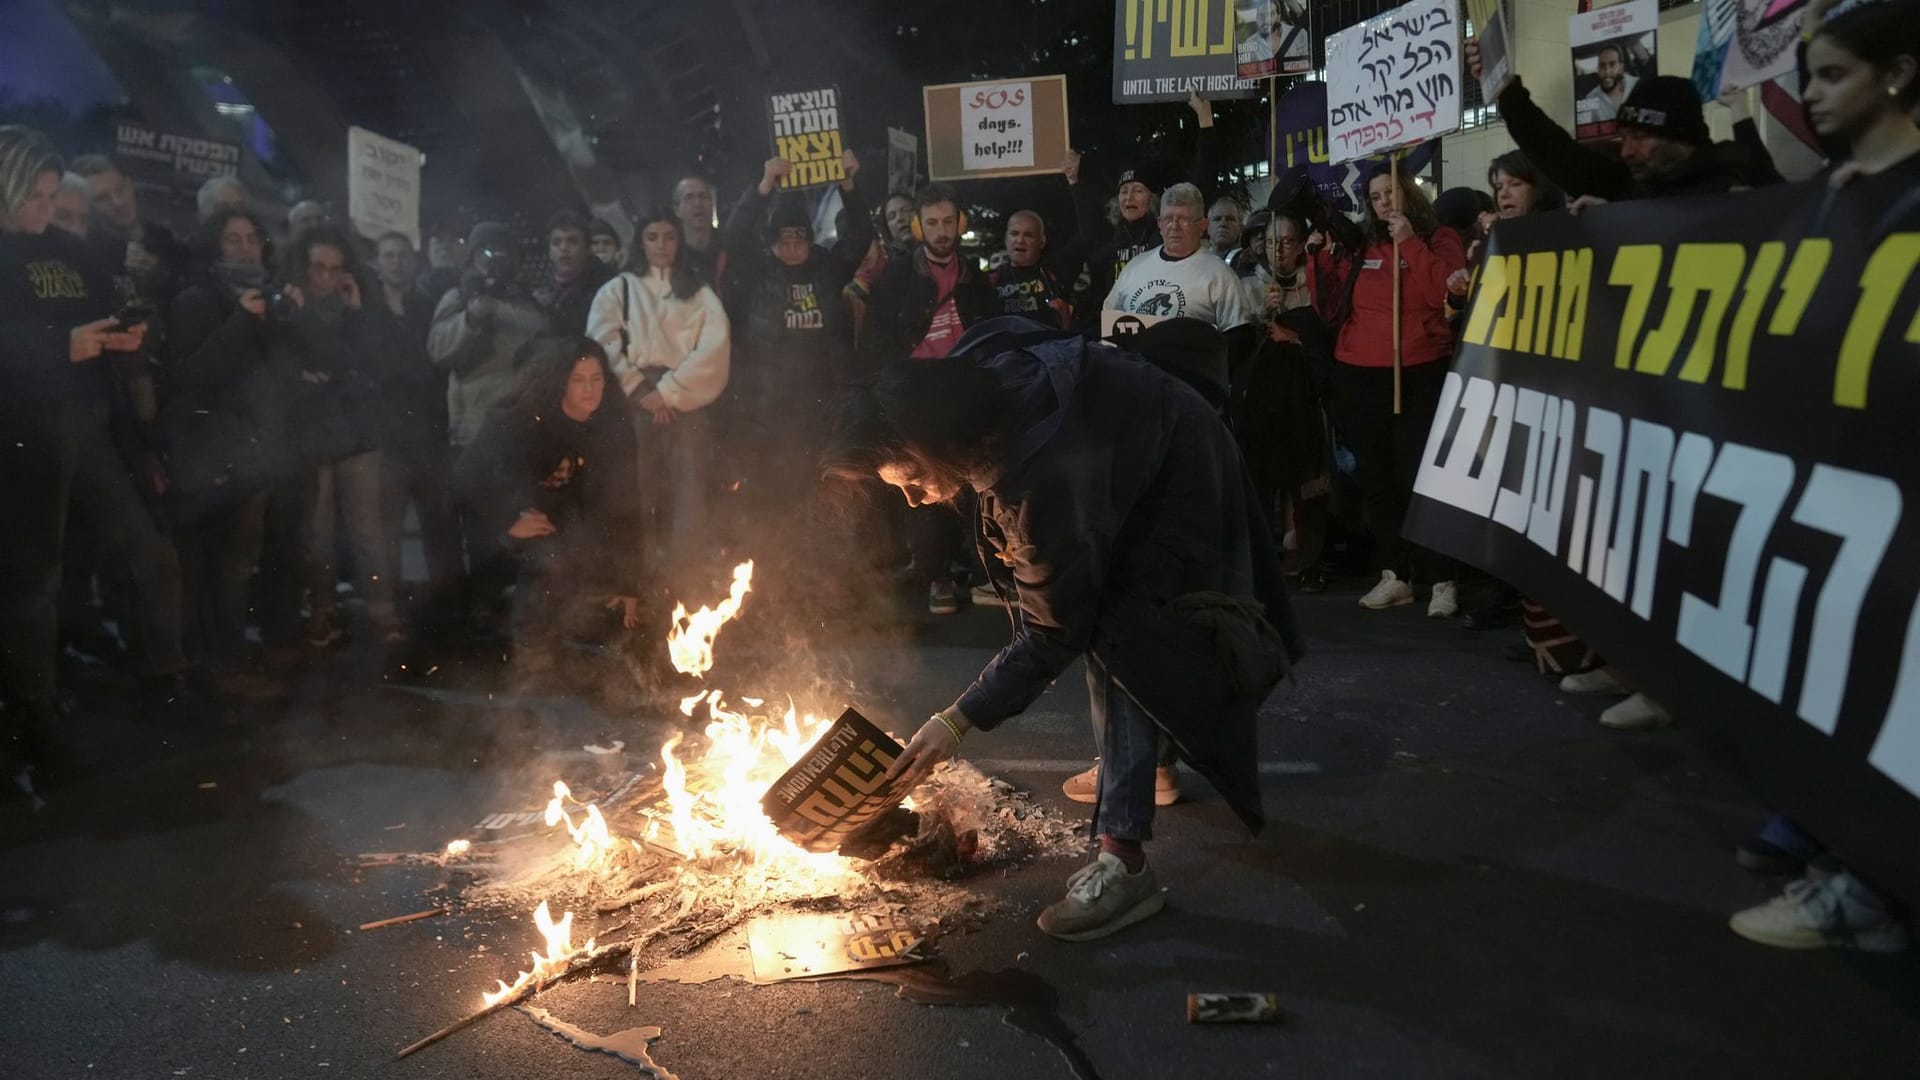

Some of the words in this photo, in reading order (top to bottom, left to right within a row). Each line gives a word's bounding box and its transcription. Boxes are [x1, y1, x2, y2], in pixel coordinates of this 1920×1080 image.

[1357, 8, 1451, 63] בישראל
[1362, 54, 1395, 92] יקר
[1399, 40, 1451, 80] הכל
[968, 88, 1025, 110] SOS
[1123, 78, 1153, 95] UNTIL
[1155, 77, 1177, 93] THE
[1178, 76, 1205, 92] LAST
[1416, 73, 1453, 109] חוץ
[771, 89, 836, 113] תוציאו
[1331, 98, 1372, 126] אדם
[1373, 88, 1414, 115] מחיי
[773, 108, 840, 137] מעזה
[978, 117, 1021, 133] days.
[1336, 114, 1403, 152] להפקיר
[1410, 110, 1436, 130] די
[117, 125, 155, 147] אש
[776, 131, 843, 162] וצאו
[975, 140, 1023, 159] help!!!
[1463, 247, 1593, 362] מתמ
[1607, 237, 1833, 391] יותר
[1566, 406, 1903, 736] הביתה
[833, 722, 858, 746] ALL
[804, 746, 840, 779] THEM
[776, 770, 807, 804] HOME
